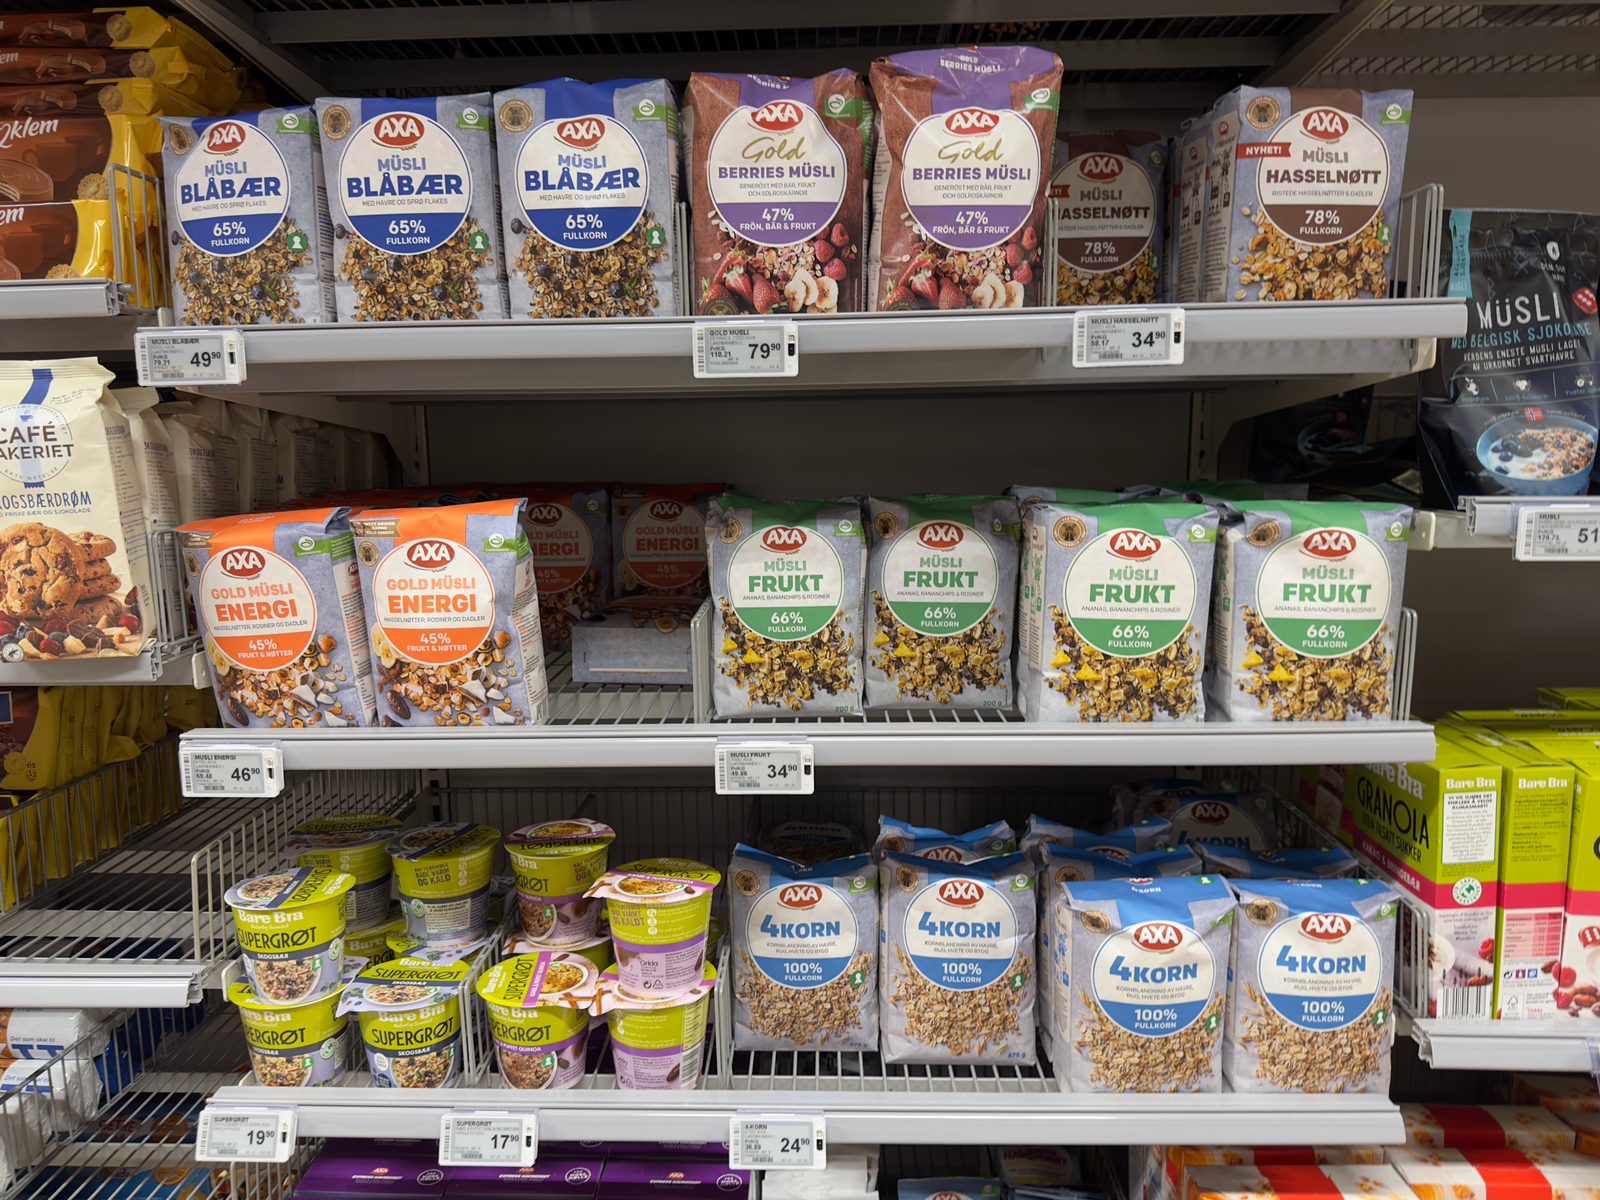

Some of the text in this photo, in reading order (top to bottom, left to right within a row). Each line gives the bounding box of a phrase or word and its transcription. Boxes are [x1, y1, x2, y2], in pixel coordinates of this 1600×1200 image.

[940, 59, 1001, 73] BERRIES MÜSLI
[752, 104, 799, 123] AXA
[950, 112, 996, 131] AXA
[378, 117, 421, 138] AXA
[562, 121, 601, 139] AXA
[1307, 112, 1344, 133] AXA
[211, 125, 242, 147] AXA
[742, 137, 806, 161] Gold
[938, 139, 1004, 163] Gold
[1246, 145, 1282, 156] NYHET!
[1302, 148, 1349, 164] MÜSLI
[205, 158, 247, 177] MÜSLI
[378, 155, 427, 172] MÜSLI
[558, 154, 606, 169] MÜSLI
[1083, 157, 1120, 174] AXA
[525, 167, 640, 191] BLÅBÆR
[719, 163, 836, 180] BERRIES MÜSLI
[912, 165, 1031, 181] BERRIES MÜSLI
[1266, 169, 1382, 185] HASSELNØTT
[181, 177, 282, 204] BLÅBÆR
[346, 172, 463, 198] BLÅBÆR
[1080, 188, 1123, 202] MÜSLI
[566, 214, 603, 228] 65%
[761, 208, 795, 222] 47%
[955, 211, 989, 225] 47%
[1305, 209, 1340, 224] 78%
[213, 221, 247, 236] 65%
[388, 219, 426, 235] 65%
[1300, 227, 1343, 235] FULLKORN
[211, 238, 250, 247] FULLKORN
[386, 236, 430, 244] FULLKORN
[563, 231, 607, 240] FULLKORN
[1085, 242, 1116, 255] 78%
[1081, 256, 1119, 264] FULLKORN
[1476, 292, 1560, 329] MÜSLI
[1451, 337, 1467, 349] MED
[1470, 329, 1521, 349] BELGISK
[1472, 350, 1575, 371] AV URKORNET SVARTHAVRE
[0, 490, 91, 510] OGSBÆRDRØM
[766, 529, 803, 545] AXA
[923, 526, 960, 542] AXA
[1309, 532, 1352, 551] AXA
[636, 538, 699, 551] ENERGI
[1114, 533, 1157, 552] AXA
[412, 543, 450, 562] AXA
[226, 552, 262, 570] AXA
[764, 558, 807, 572] MÜSLI
[920, 555, 963, 568] MÜSLI
[903, 571, 979, 588] FRUKT
[1109, 564, 1158, 580] MÜSLI
[1302, 564, 1354, 580] MÜSLI
[211, 583, 293, 599] GOLD MÜSLI
[387, 576, 476, 591] GOLD MÜSLI
[748, 575, 823, 592] FRUKT
[1089, 584, 1175, 603] FRUKT
[1283, 583, 1372, 603] FRUKT
[214, 600, 298, 622] ENERGI
[388, 594, 477, 614] ENERGI
[771, 612, 804, 624] 66%
[924, 607, 957, 619] 66%
[420, 633, 451, 644] 45%
[1112, 625, 1149, 639] 66%
[1307, 625, 1345, 638] 66%
[249, 639, 277, 650] 45%
[1108, 640, 1152, 648] FULLKORN
[1302, 640, 1348, 648] FULLKORN
[1446, 778, 1496, 789] Bare Bra
[1519, 777, 1568, 789] Bare Bra
[1357, 776, 1429, 849] GRANOLA
[1396, 836, 1422, 863] SUKKER
[430, 874, 451, 885] KALD
[784, 888, 817, 901] AXA
[943, 881, 980, 899] AXA
[238, 909, 304, 924] Bare Bra
[918, 911, 1000, 938] 4KORN
[1305, 914, 1347, 933] AXA
[760, 914, 840, 938] 4KORN
[237, 927, 317, 949] SUPERGRØT
[1138, 927, 1179, 945] AXA
[1276, 945, 1366, 974] 4KORN
[371, 968, 462, 980] SUPERGRØT
[784, 962, 823, 974] 100%
[942, 962, 982, 974] 100%
[1110, 956, 1198, 984] 4KORN
[379, 1005, 445, 1022] Bare Bra
[1134, 1008, 1177, 1022] 100%
[1301, 1001, 1345, 1014] 100%
[1301, 1014, 1344, 1023] FULLKORN
[372, 1016, 455, 1046] SUPERGRØT
